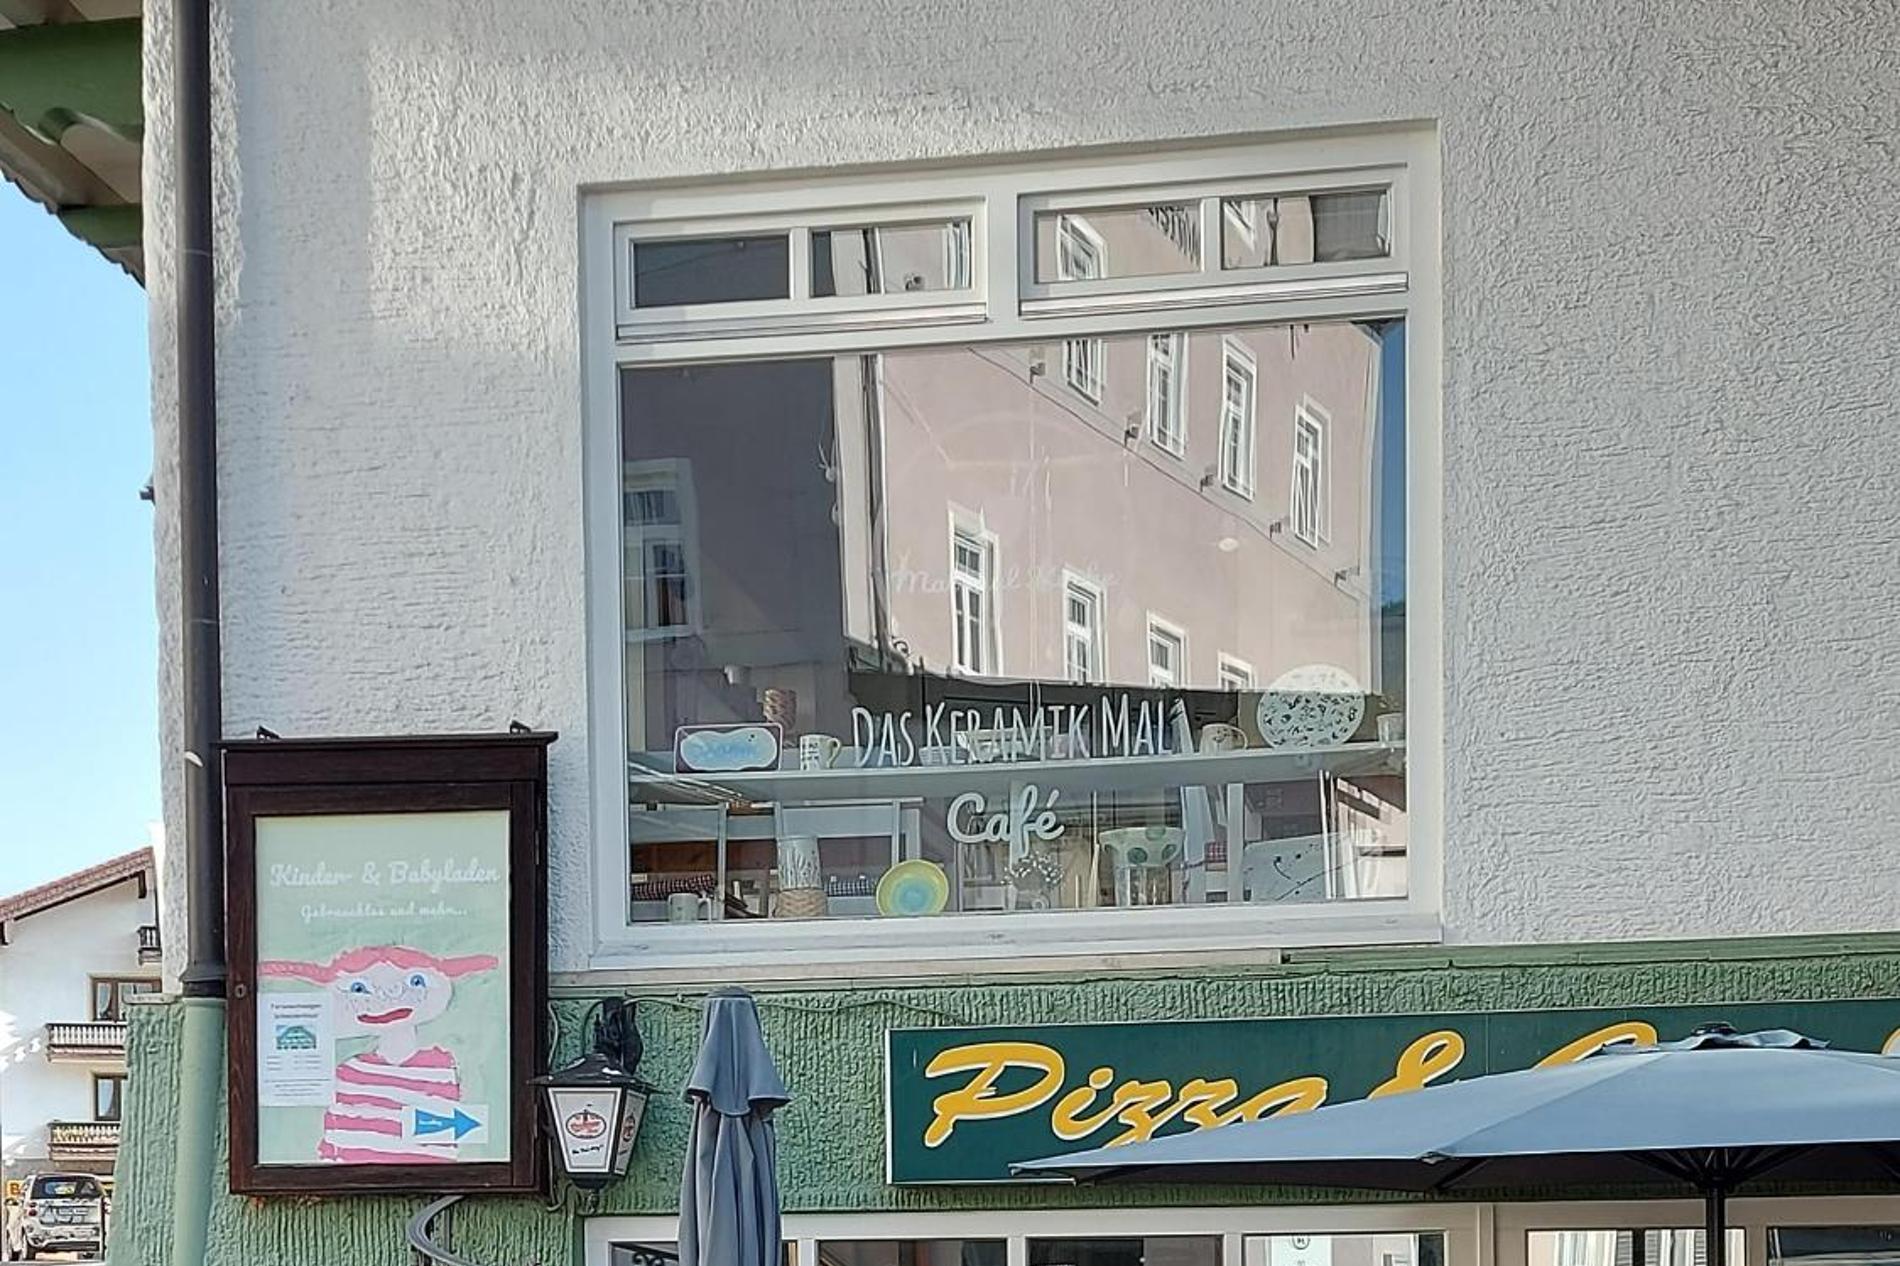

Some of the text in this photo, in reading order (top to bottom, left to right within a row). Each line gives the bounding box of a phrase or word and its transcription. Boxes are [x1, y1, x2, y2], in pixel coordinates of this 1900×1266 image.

[851, 705, 913, 768] DAS
[925, 701, 1090, 766] KERAMIK
[947, 784, 1065, 858] Café
[362, 860, 380, 886] &
[388, 857, 501, 894] Babyladen
